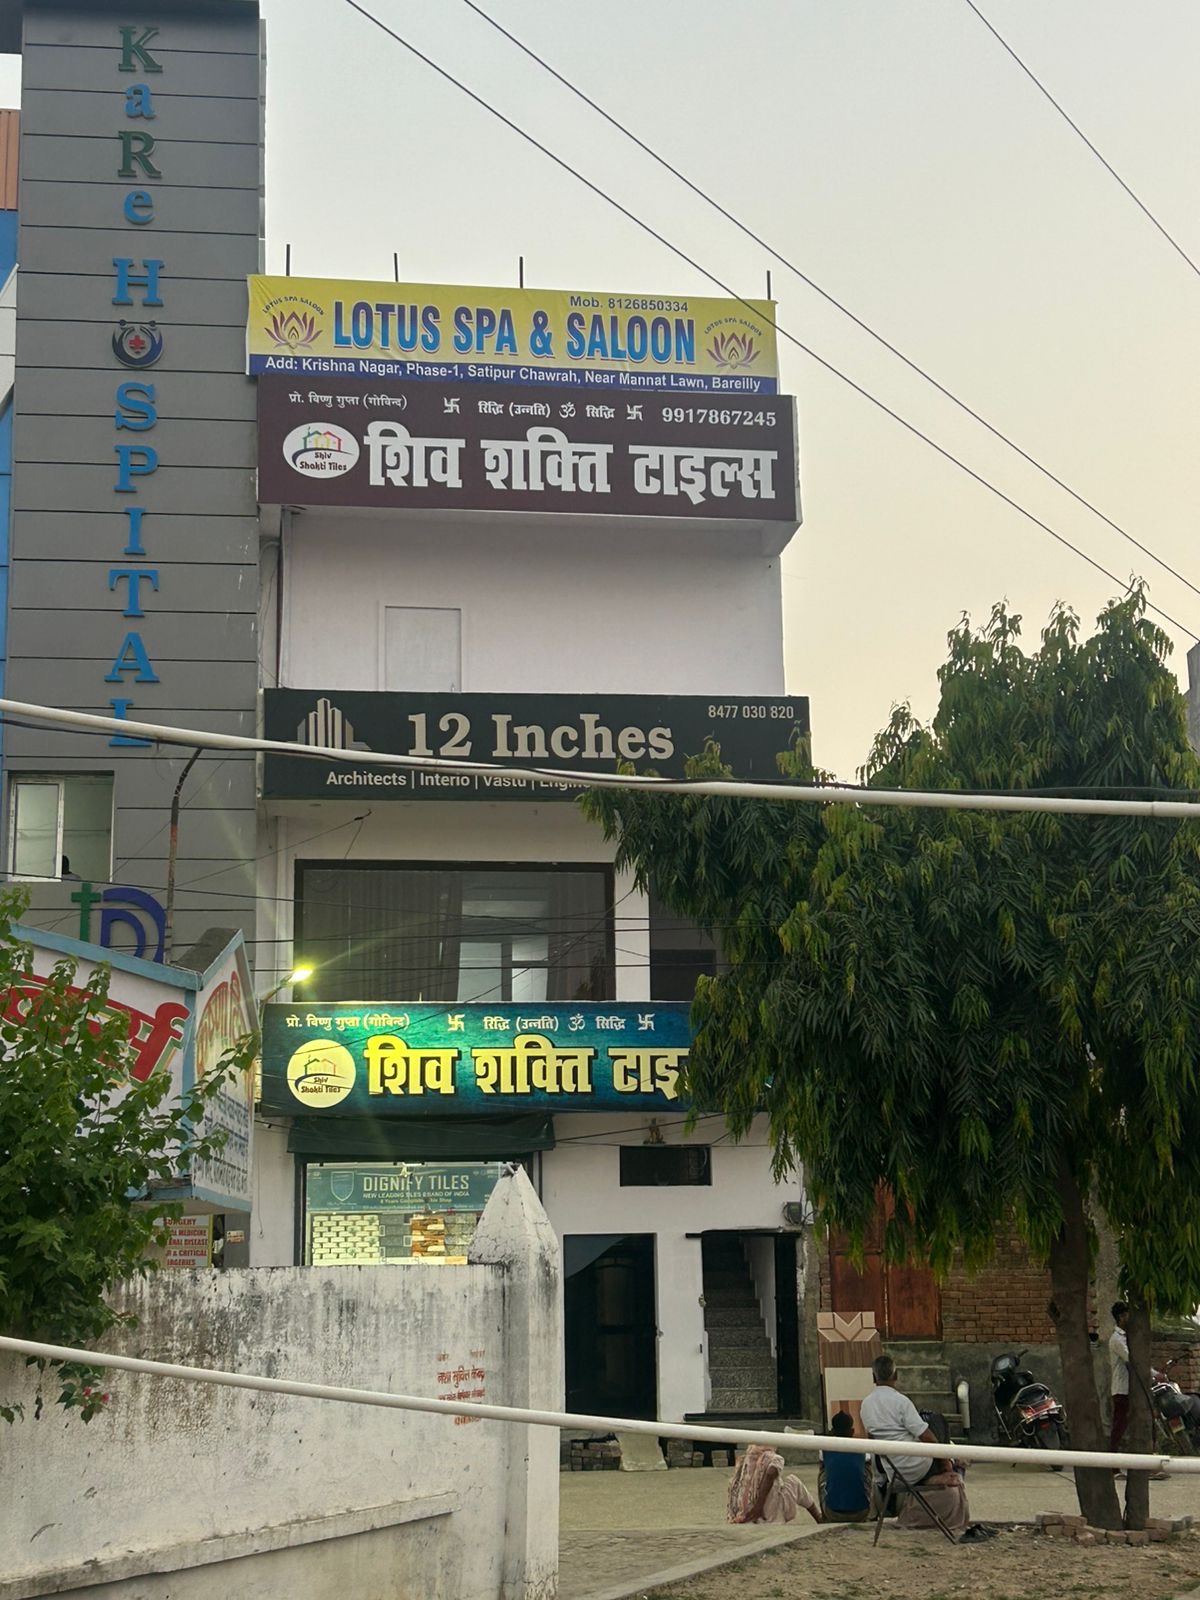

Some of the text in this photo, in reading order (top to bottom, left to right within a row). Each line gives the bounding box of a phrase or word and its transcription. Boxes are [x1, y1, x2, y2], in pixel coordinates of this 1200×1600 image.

[570, 295, 689, 312] Mob. 8126850334
[334, 301, 696, 365] LOTUS SPA & SALOON
[266, 356, 761, 393] Add: Krishna Nagar, Phase-1, Satipur Chawrah, Near Mannat Lawn, Bareilly
[336, 395, 360, 408] गुप्ता
[509, 402, 551, 418] (उन्नति)
[586, 405, 615, 419] सिद्धि
[662, 407, 776, 427] 9917867245
[314, 452, 332, 460] Shiv
[363, 420, 778, 505] शिव शक्ति टाइल्स
[299, 461, 347, 472] Shakti Tiles
[708, 705, 794, 719] 8477 030 820
[408, 713, 675, 760] 12 Inches
[326, 771, 407, 786] Architects
[420, 772, 470, 786] Interio
[483, 1015, 510, 1031] रिद्धि
[515, 1015, 559, 1032] (उन्नति)
[595, 1015, 626, 1031] सिद्धि
[363, 1034, 459, 1095] शिव
[471, 1033, 595, 1094] शक्ति
[428, 1174, 469, 1190] TILES
